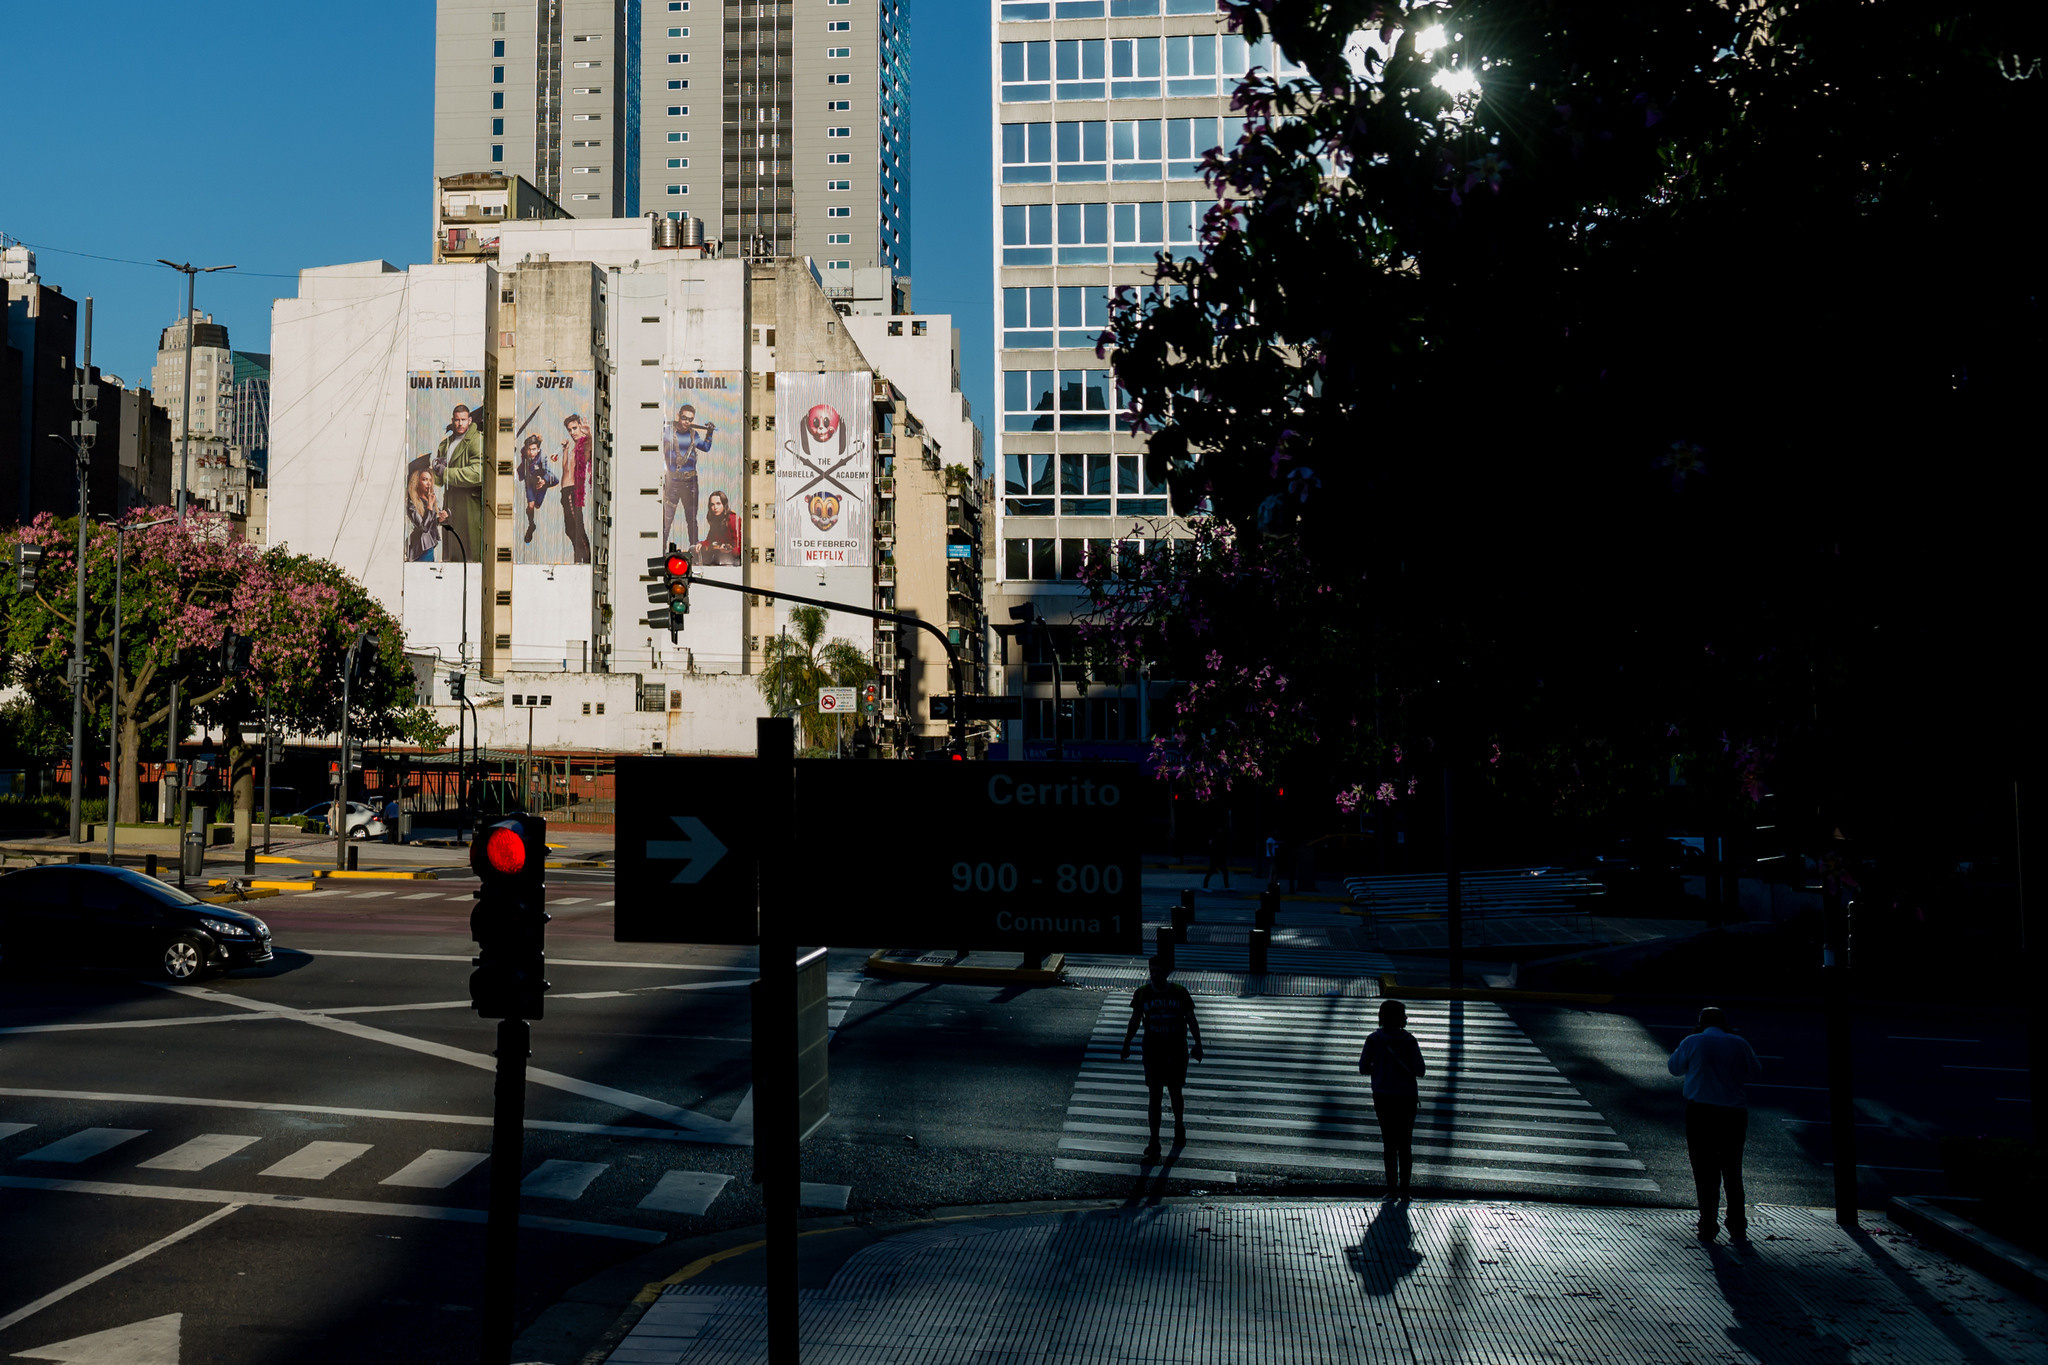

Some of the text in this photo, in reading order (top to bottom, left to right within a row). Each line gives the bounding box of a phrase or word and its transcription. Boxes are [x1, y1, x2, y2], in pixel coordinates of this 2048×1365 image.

[410, 376, 481, 389] UNA FAMILIA
[536, 376, 573, 389] SUPER
[678, 376, 728, 389] NORMAL
[818, 458, 831, 466] THE
[777, 470, 869, 479] UMBRELLA ACADEMY
[793, 540, 858, 548] 15 DE FEBRERO
[806, 550, 844, 561] NETFLIX
[987, 773, 1121, 808] Cerrito
[951, 861, 1018, 893] 900
[1055, 863, 1124, 896] 800
[995, 911, 1121, 935] Comuna 1
